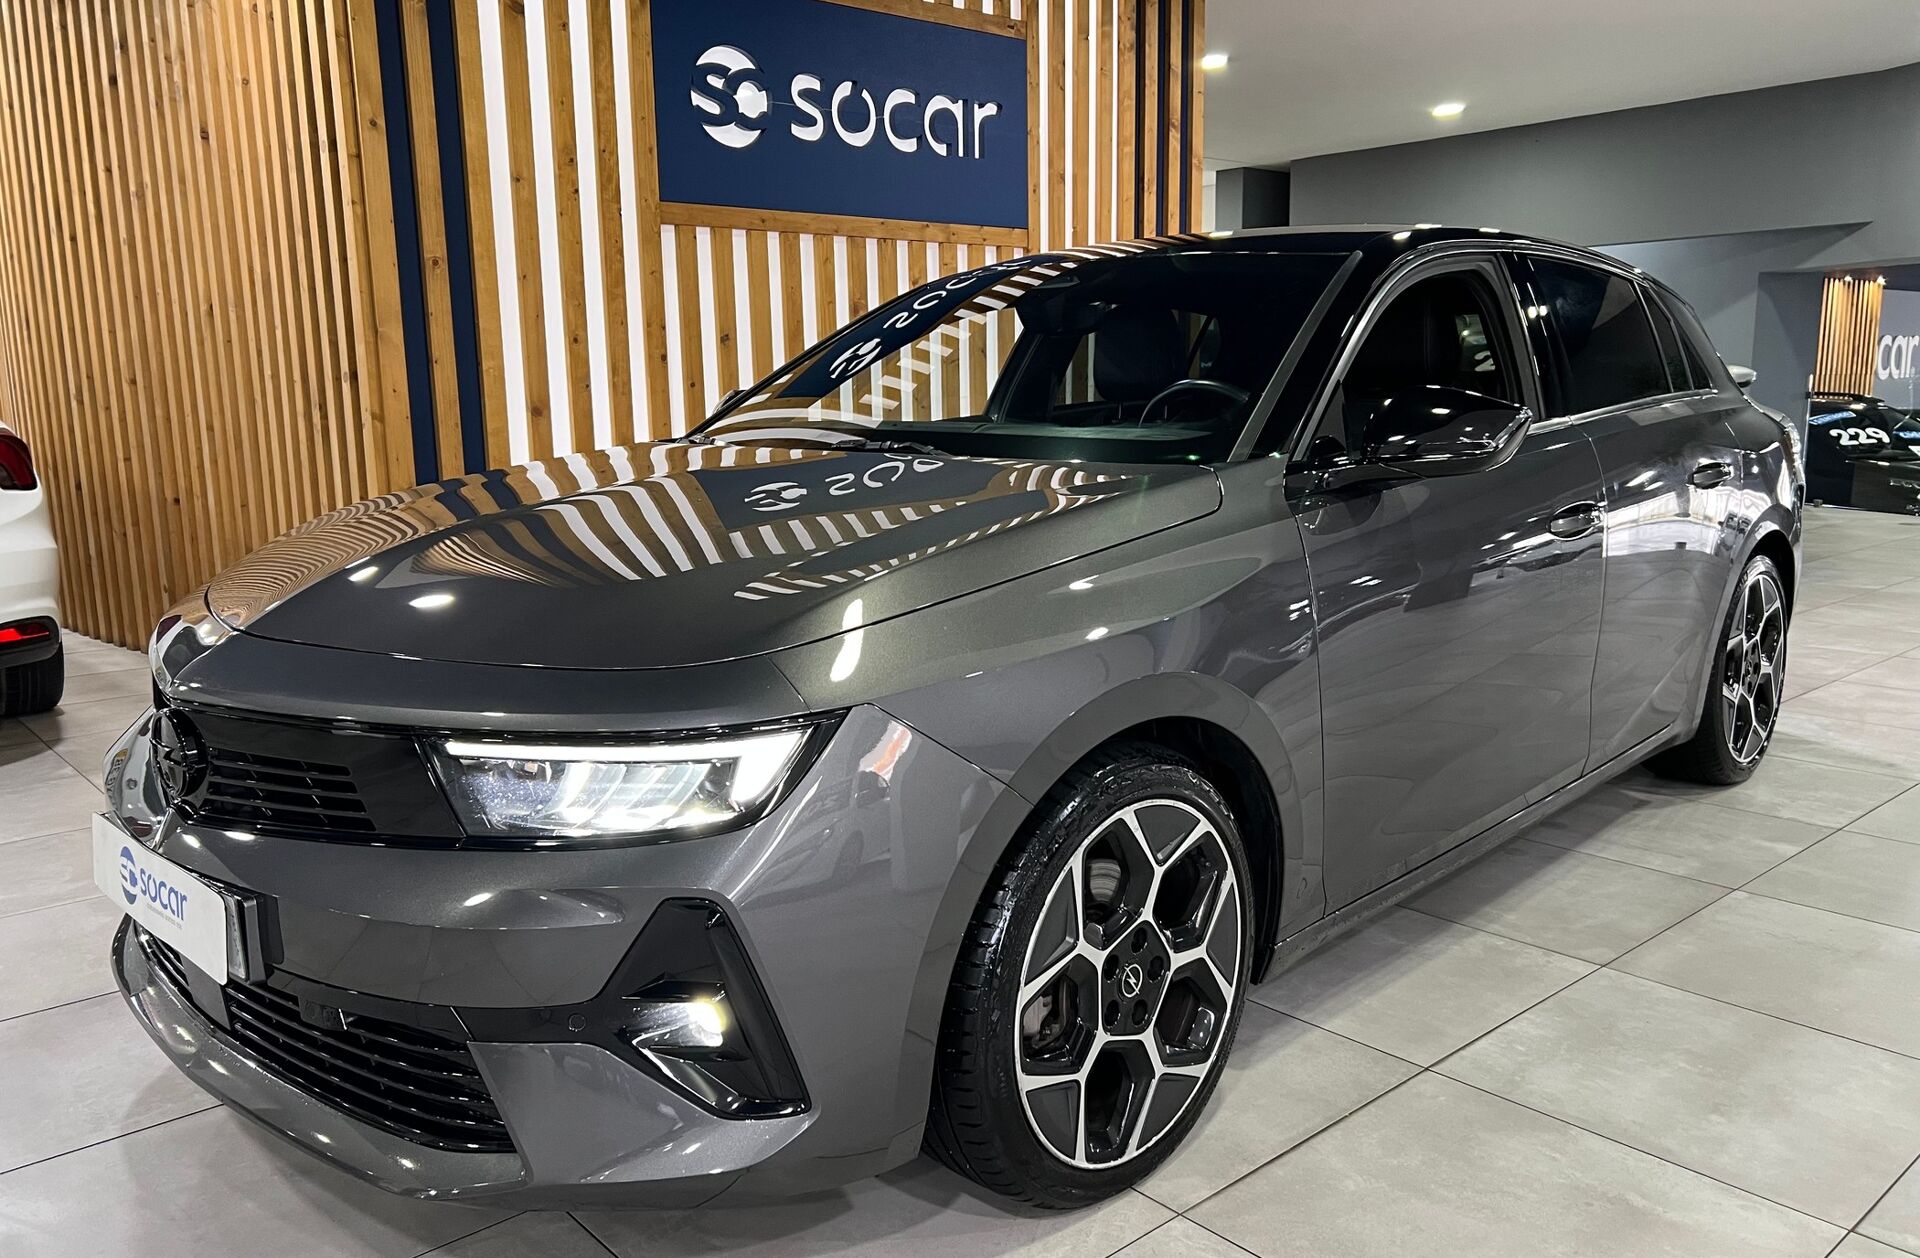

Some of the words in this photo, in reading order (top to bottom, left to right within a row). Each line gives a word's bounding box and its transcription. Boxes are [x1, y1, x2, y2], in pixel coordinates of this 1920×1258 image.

[790, 73, 998, 159] socar
[1829, 427, 1891, 446] 229
[140, 867, 187, 921] socar
